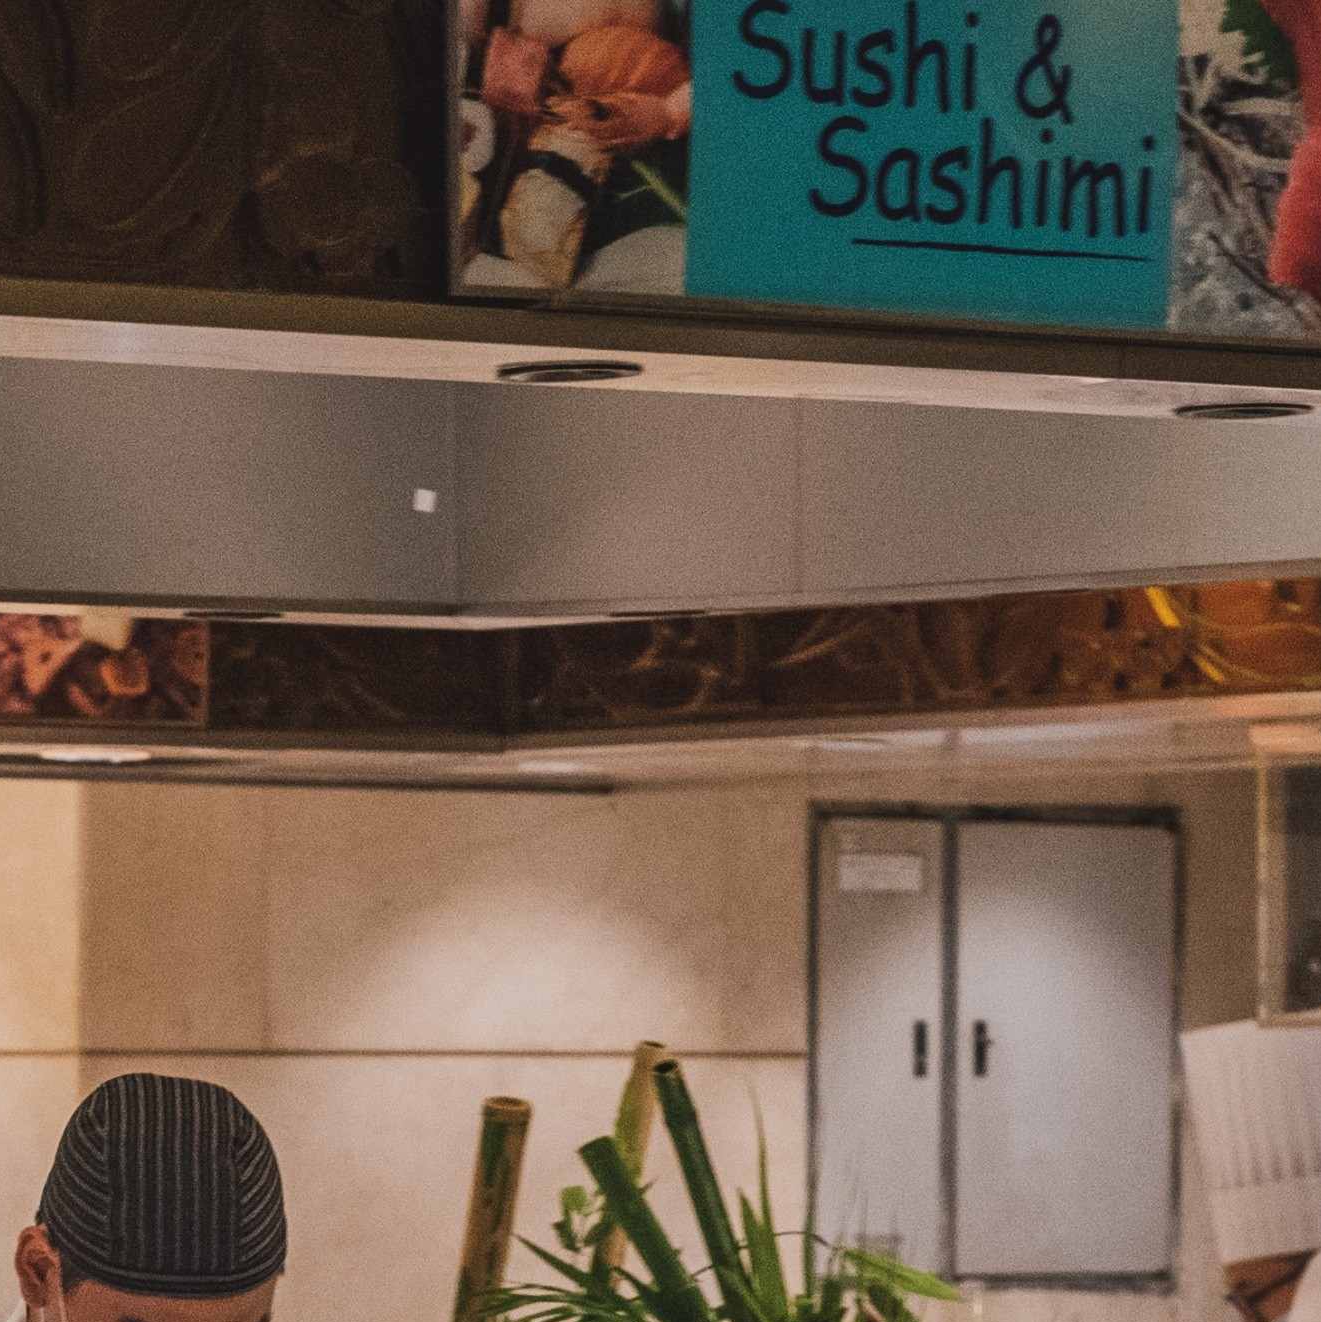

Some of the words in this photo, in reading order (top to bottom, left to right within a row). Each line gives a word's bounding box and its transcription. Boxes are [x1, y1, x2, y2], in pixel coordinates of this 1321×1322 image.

[730, 0, 981, 115] Sushi
[1013, 12, 1075, 125] &
[807, 114, 1155, 239] Sashimi
